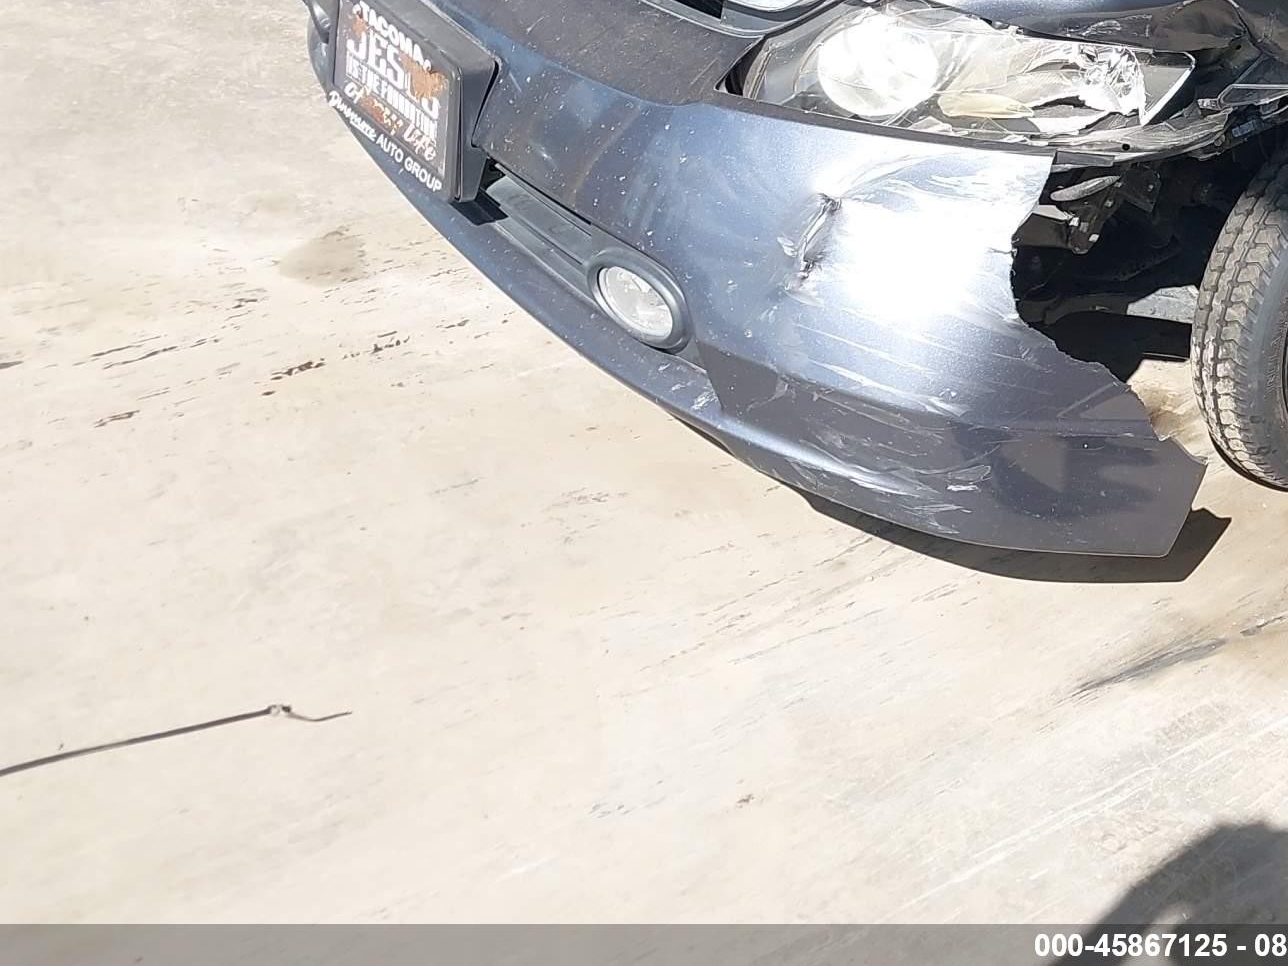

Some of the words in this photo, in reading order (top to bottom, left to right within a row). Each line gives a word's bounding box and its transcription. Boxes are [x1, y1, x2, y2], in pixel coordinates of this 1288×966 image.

[360, 0, 424, 66] TACOMA
[376, 134, 404, 163] AUTO
[404, 156, 442, 192] GROUP
